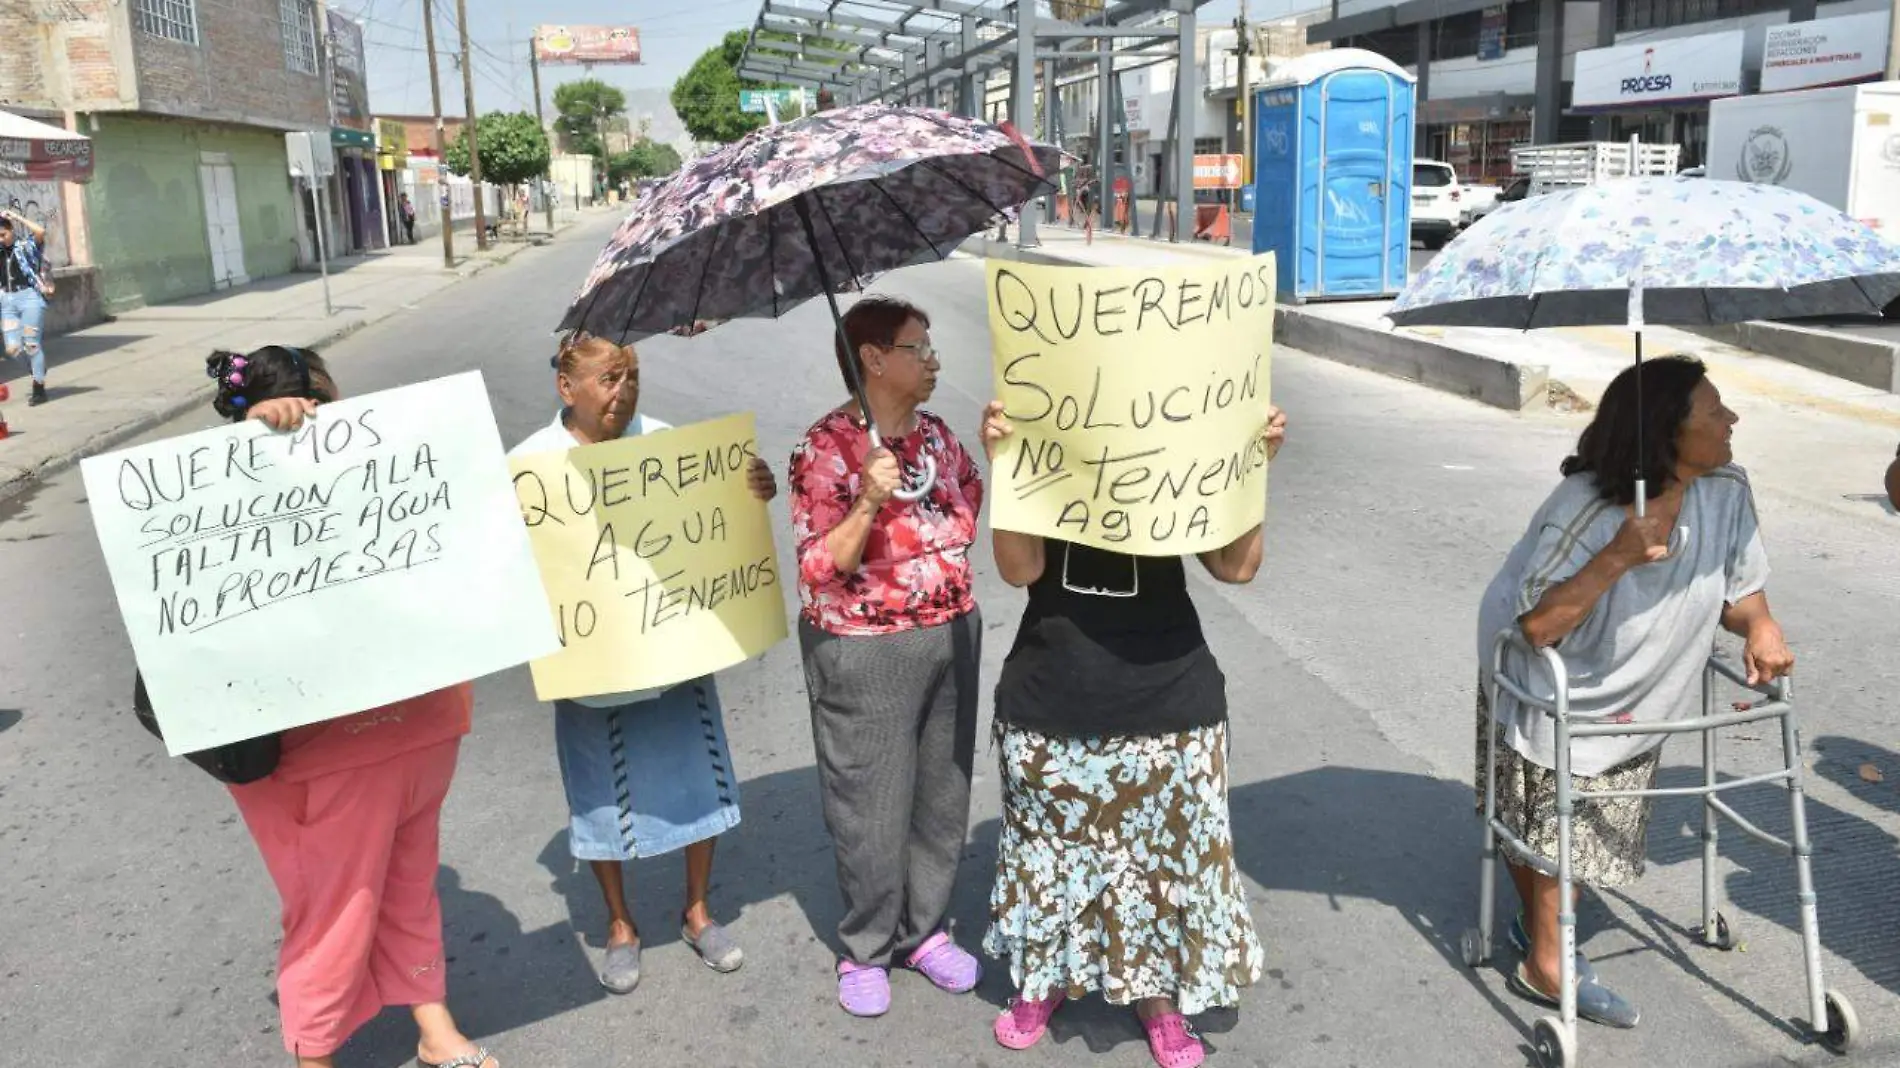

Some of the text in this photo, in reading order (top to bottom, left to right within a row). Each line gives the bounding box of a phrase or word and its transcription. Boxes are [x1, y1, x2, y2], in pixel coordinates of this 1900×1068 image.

[1620, 74, 1672, 94] PROESA
[995, 264, 1269, 345] QUEREMOS
[118, 408, 382, 511] QUEREMOS
[1012, 437, 1064, 479] NO
[141, 470, 354, 539] SOLUCION
[293, 512, 342, 548] DE
[358, 480, 451, 539] AGUA
[215, 523, 442, 618] PROMESAS
[586, 506, 727, 581] AGUA
[624, 556, 776, 635] TENEMOS
